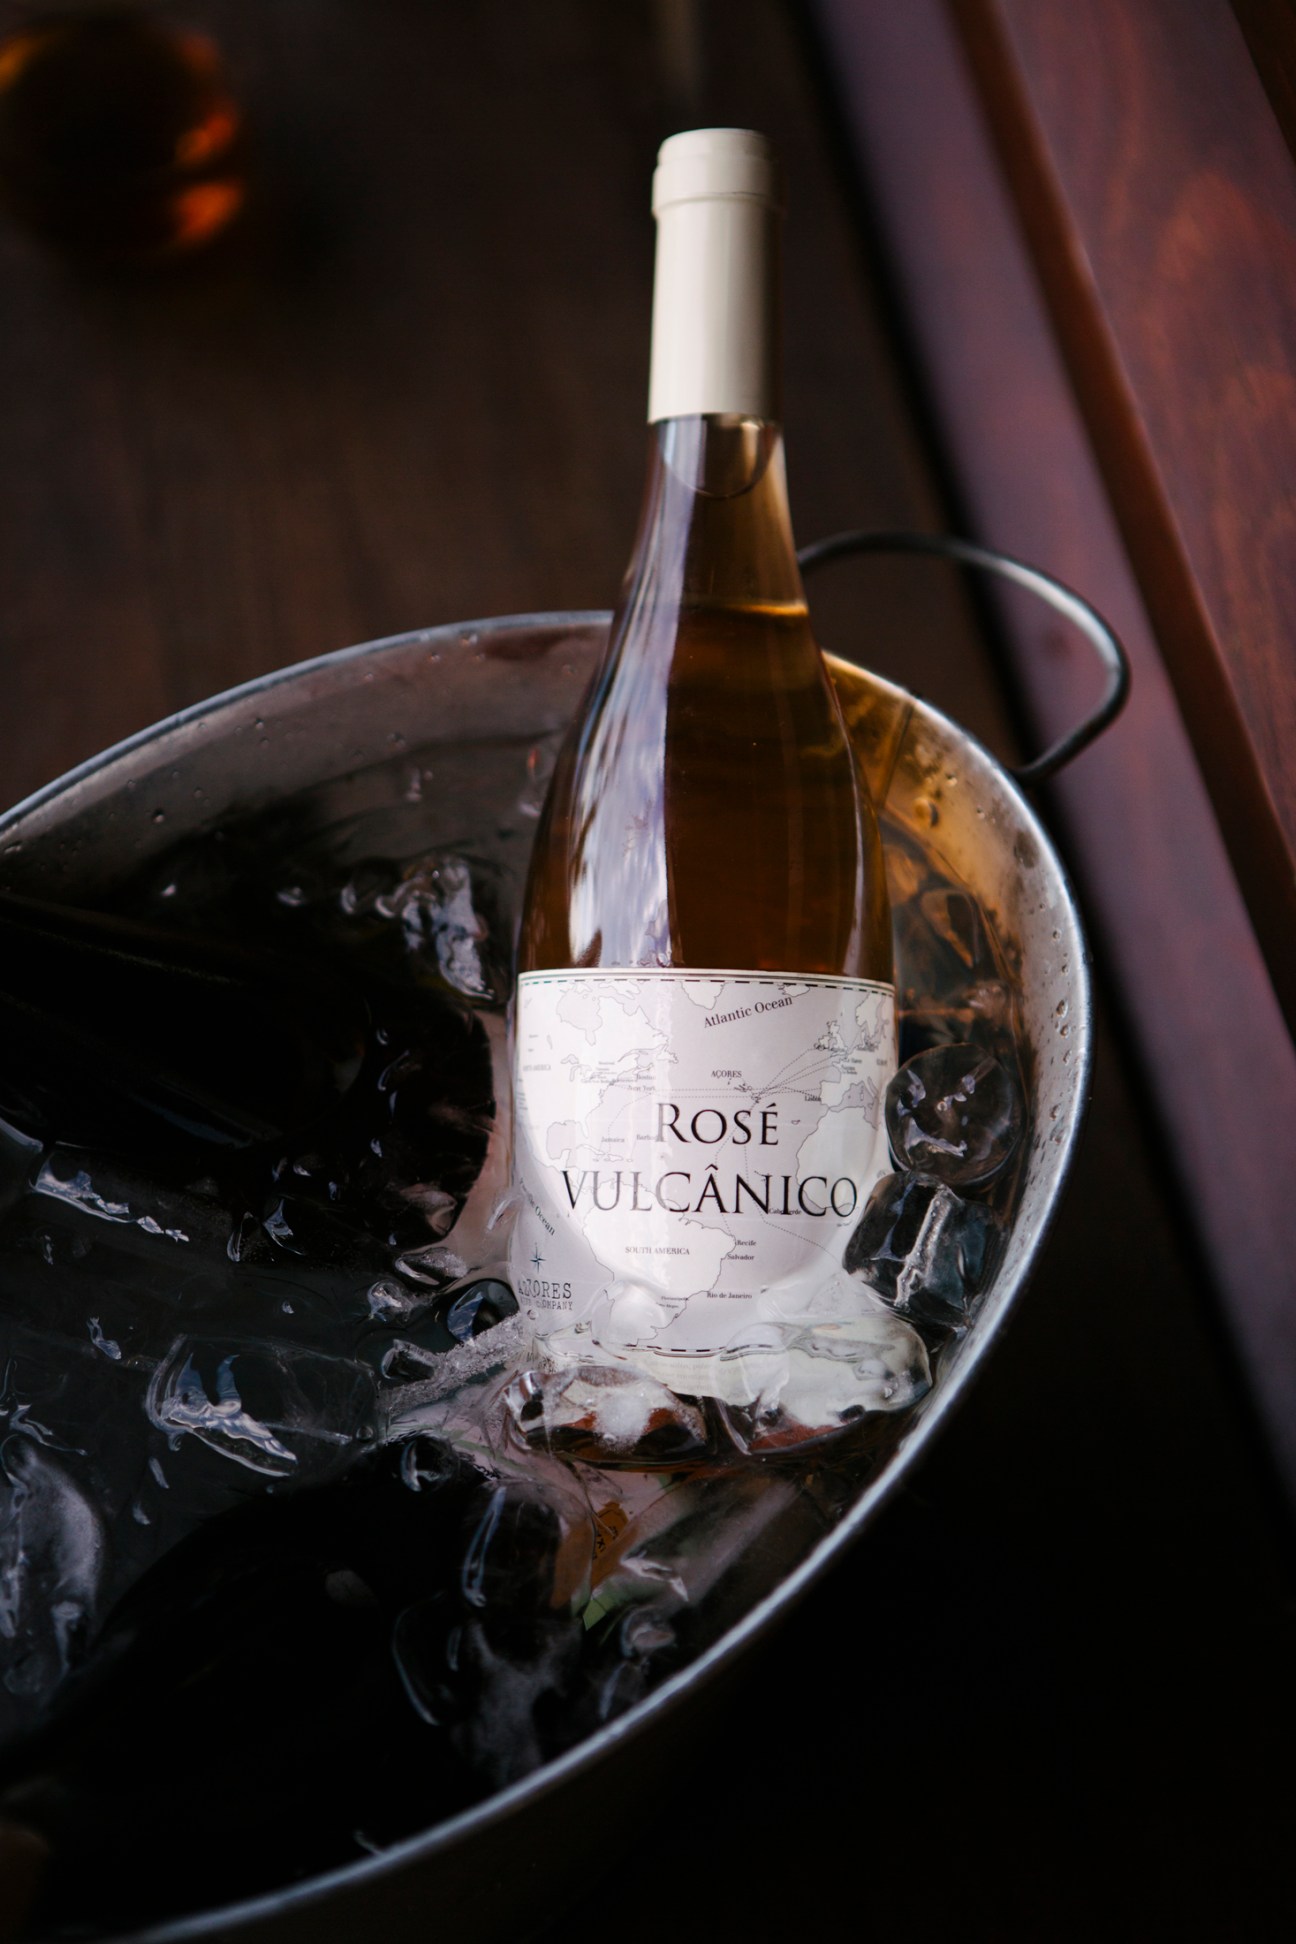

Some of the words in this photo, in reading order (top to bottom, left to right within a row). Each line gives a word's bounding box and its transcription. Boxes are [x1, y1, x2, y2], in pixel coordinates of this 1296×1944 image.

[704, 1007, 752, 1028] Atlantic
[755, 997, 793, 1014] Ocean
[711, 1070, 742, 1079] AÇORES
[657, 1102, 779, 1146] ROSÉ
[561, 1163, 858, 1218] VULCÂNICO
[535, 1205, 555, 1236] Ocean
[625, 1246, 652, 1255] SOUTH
[654, 1247, 690, 1256] AMERICA
[727, 1253, 755, 1261] Salvador
